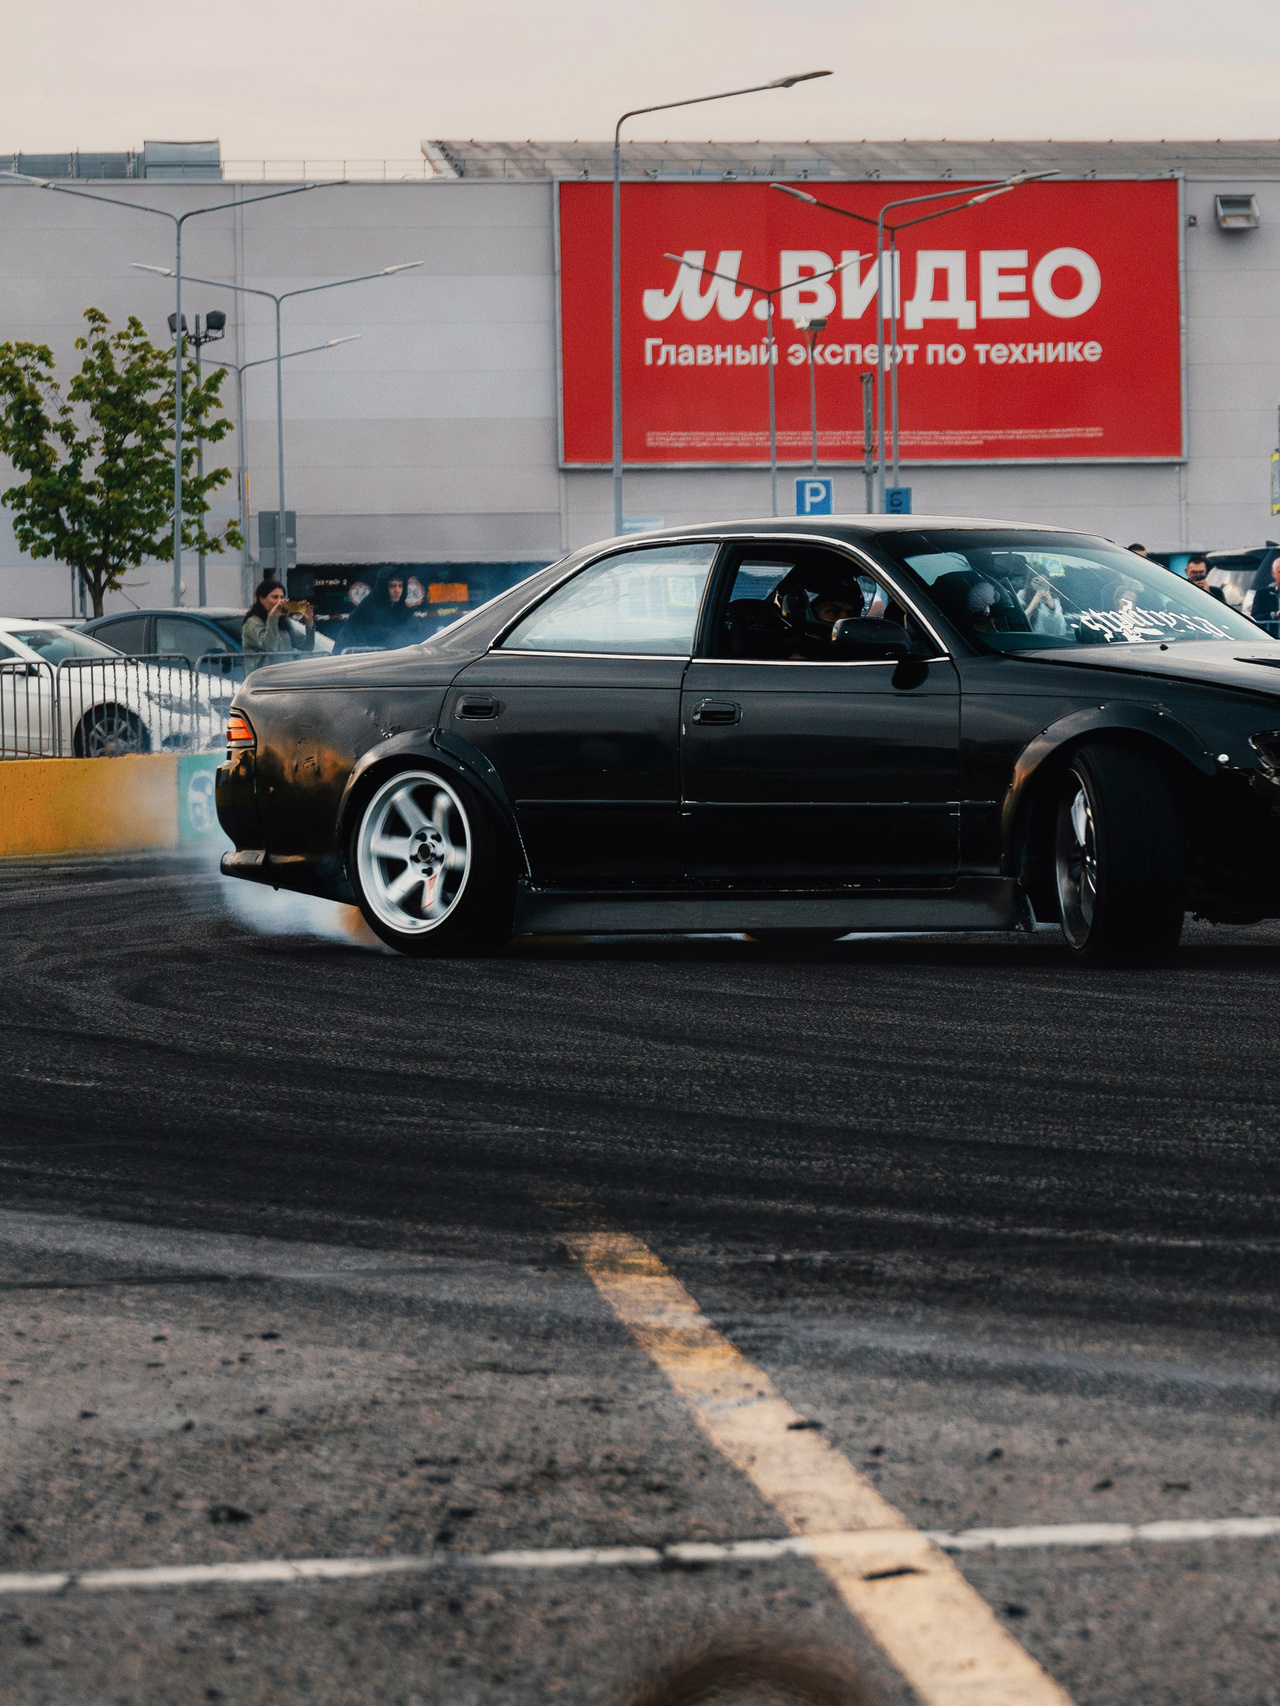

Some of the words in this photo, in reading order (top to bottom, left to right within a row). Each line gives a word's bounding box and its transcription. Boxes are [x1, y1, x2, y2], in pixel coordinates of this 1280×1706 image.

[645, 337, 778, 366] Главный
[787, 343, 919, 371] эксперт
[926, 343, 967, 365] по
[973, 340, 1103, 365] технике
